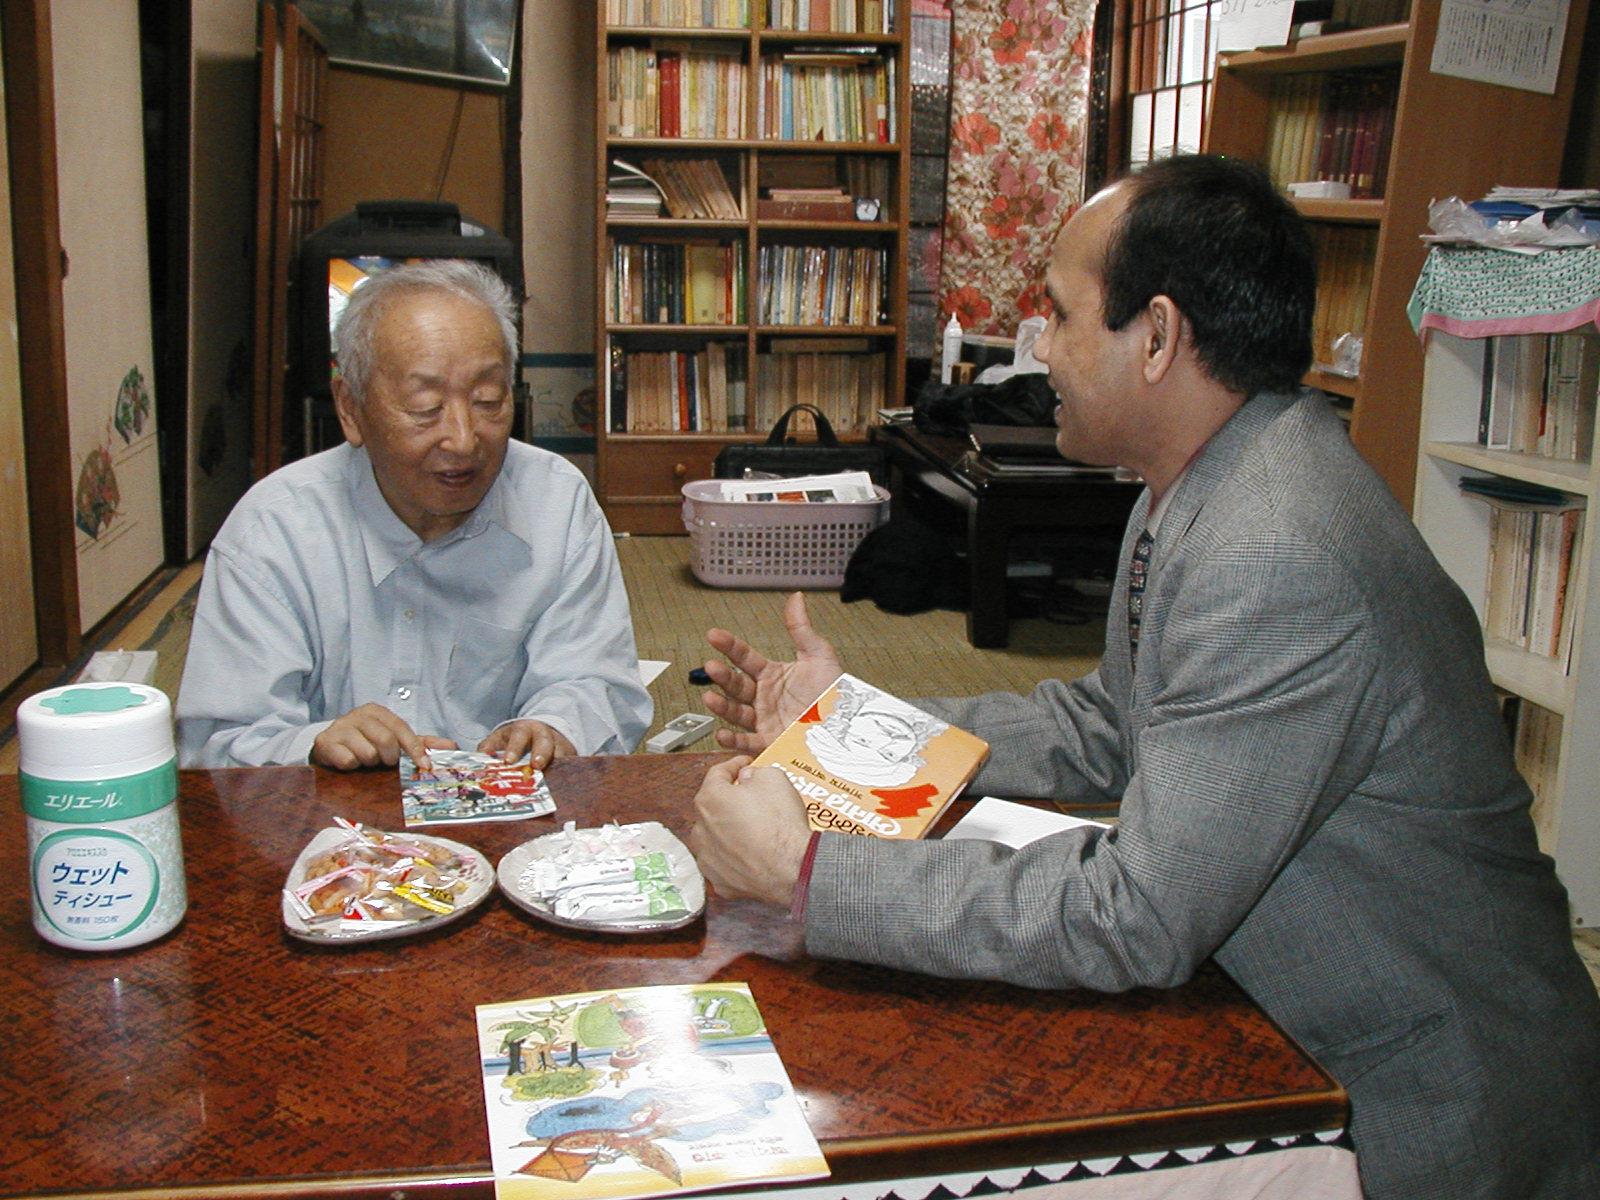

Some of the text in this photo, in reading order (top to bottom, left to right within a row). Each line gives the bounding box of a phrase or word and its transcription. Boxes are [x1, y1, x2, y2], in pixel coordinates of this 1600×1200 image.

[43, 792, 122, 812] エリエール
[824, 793, 902, 836] সোনার
[52, 860, 130, 886] ウェット
[53, 890, 133, 909] ティシュー
